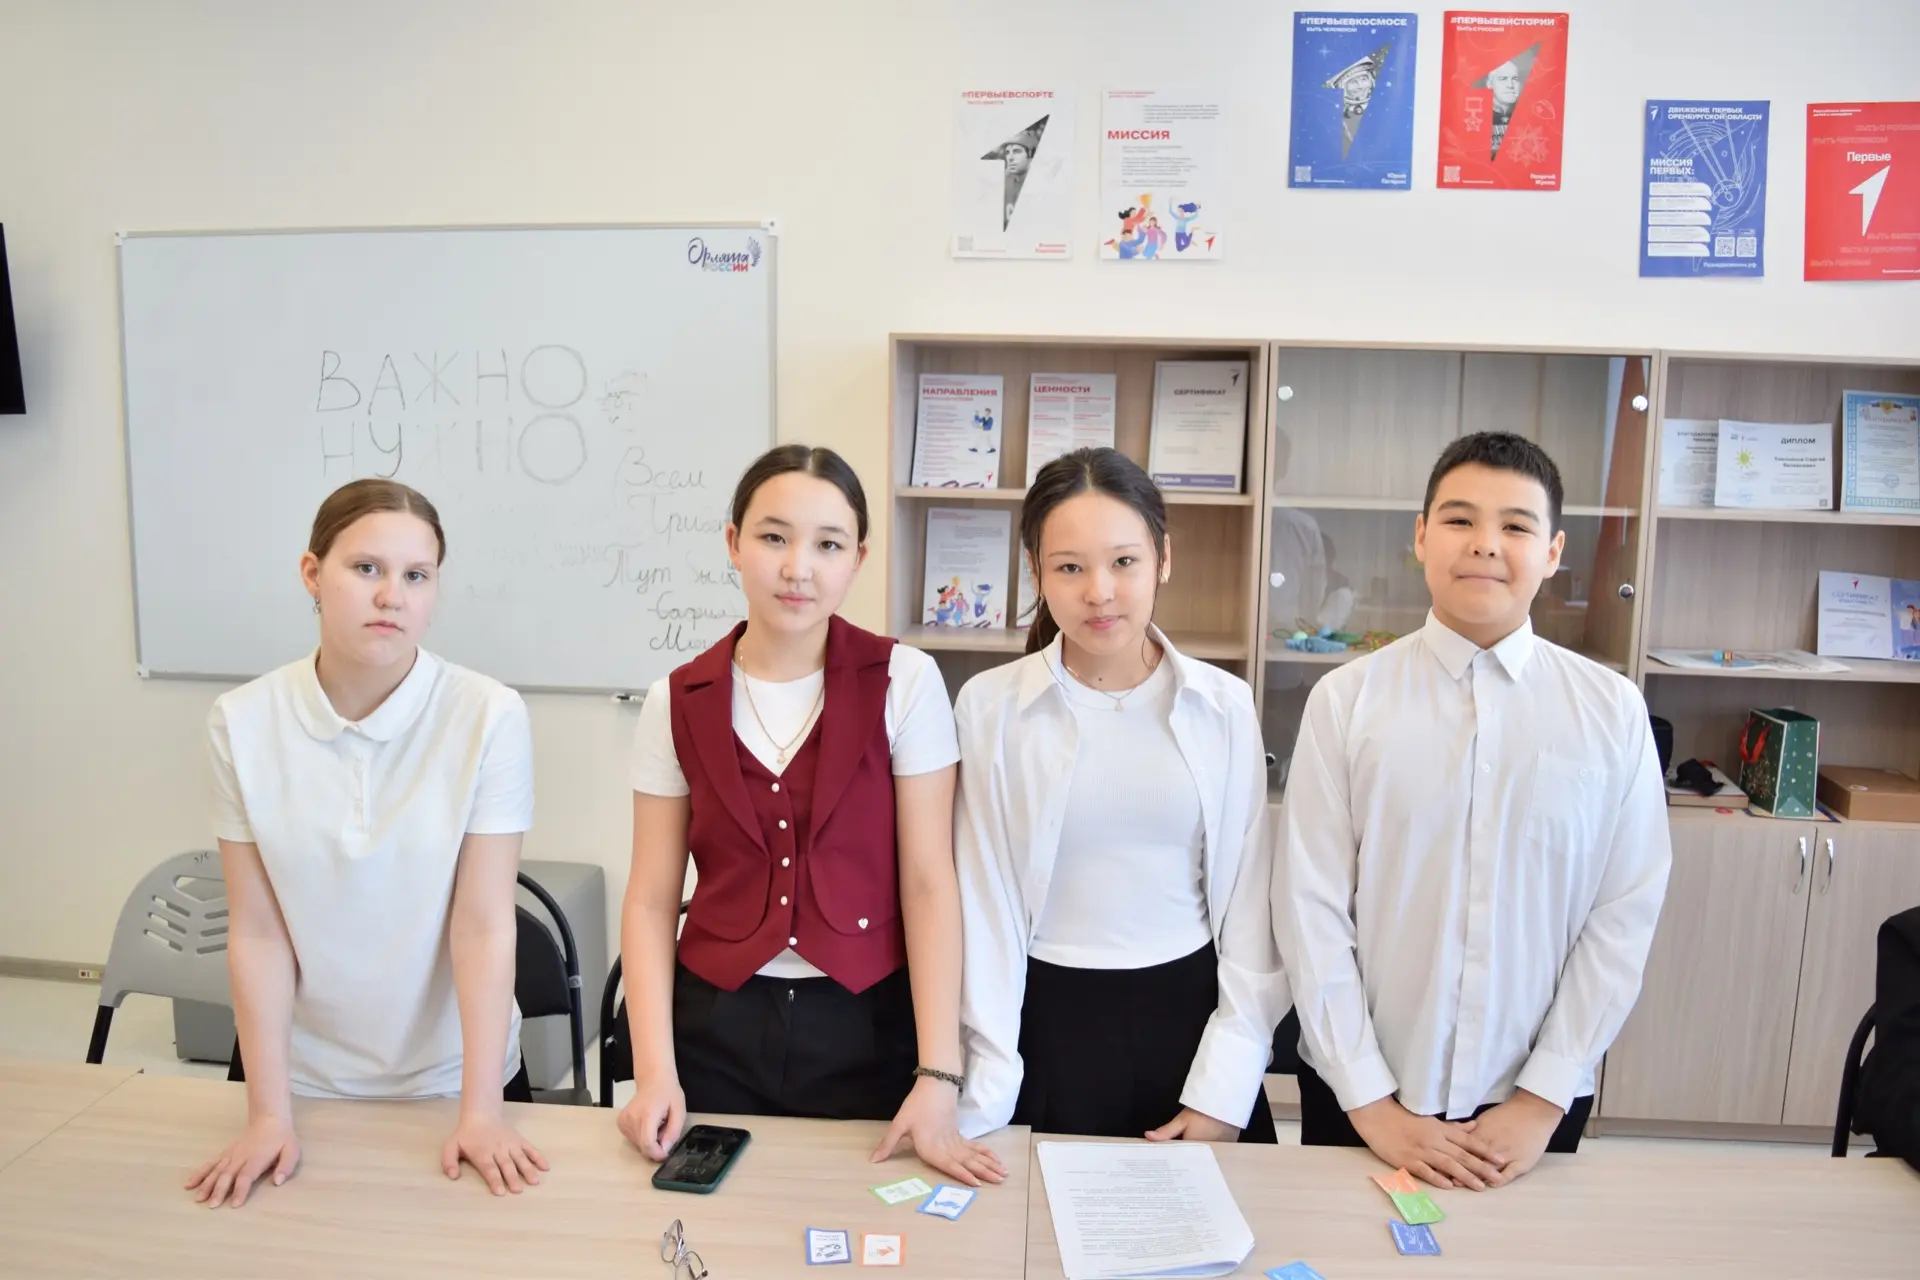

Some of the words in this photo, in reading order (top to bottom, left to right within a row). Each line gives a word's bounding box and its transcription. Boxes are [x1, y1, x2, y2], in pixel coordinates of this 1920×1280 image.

[1300, 17, 1407, 26] #ПЕРВЫЕВКОСМОСЕ
[1450, 16, 1555, 26] #ПЕРВЫЕВИСТОРИИ
[1107, 130, 1170, 140] МИССИЯ
[1847, 151, 1891, 164] Первые
[1650, 159, 1693, 167] МИССИЯ
[1650, 167, 1695, 175] ПЕРВЫХ:
[688, 237, 749, 268] Орлята
[316, 344, 587, 415] ВАЖНО
[923, 388, 998, 396] НАПРАВЛЕНИЯ
